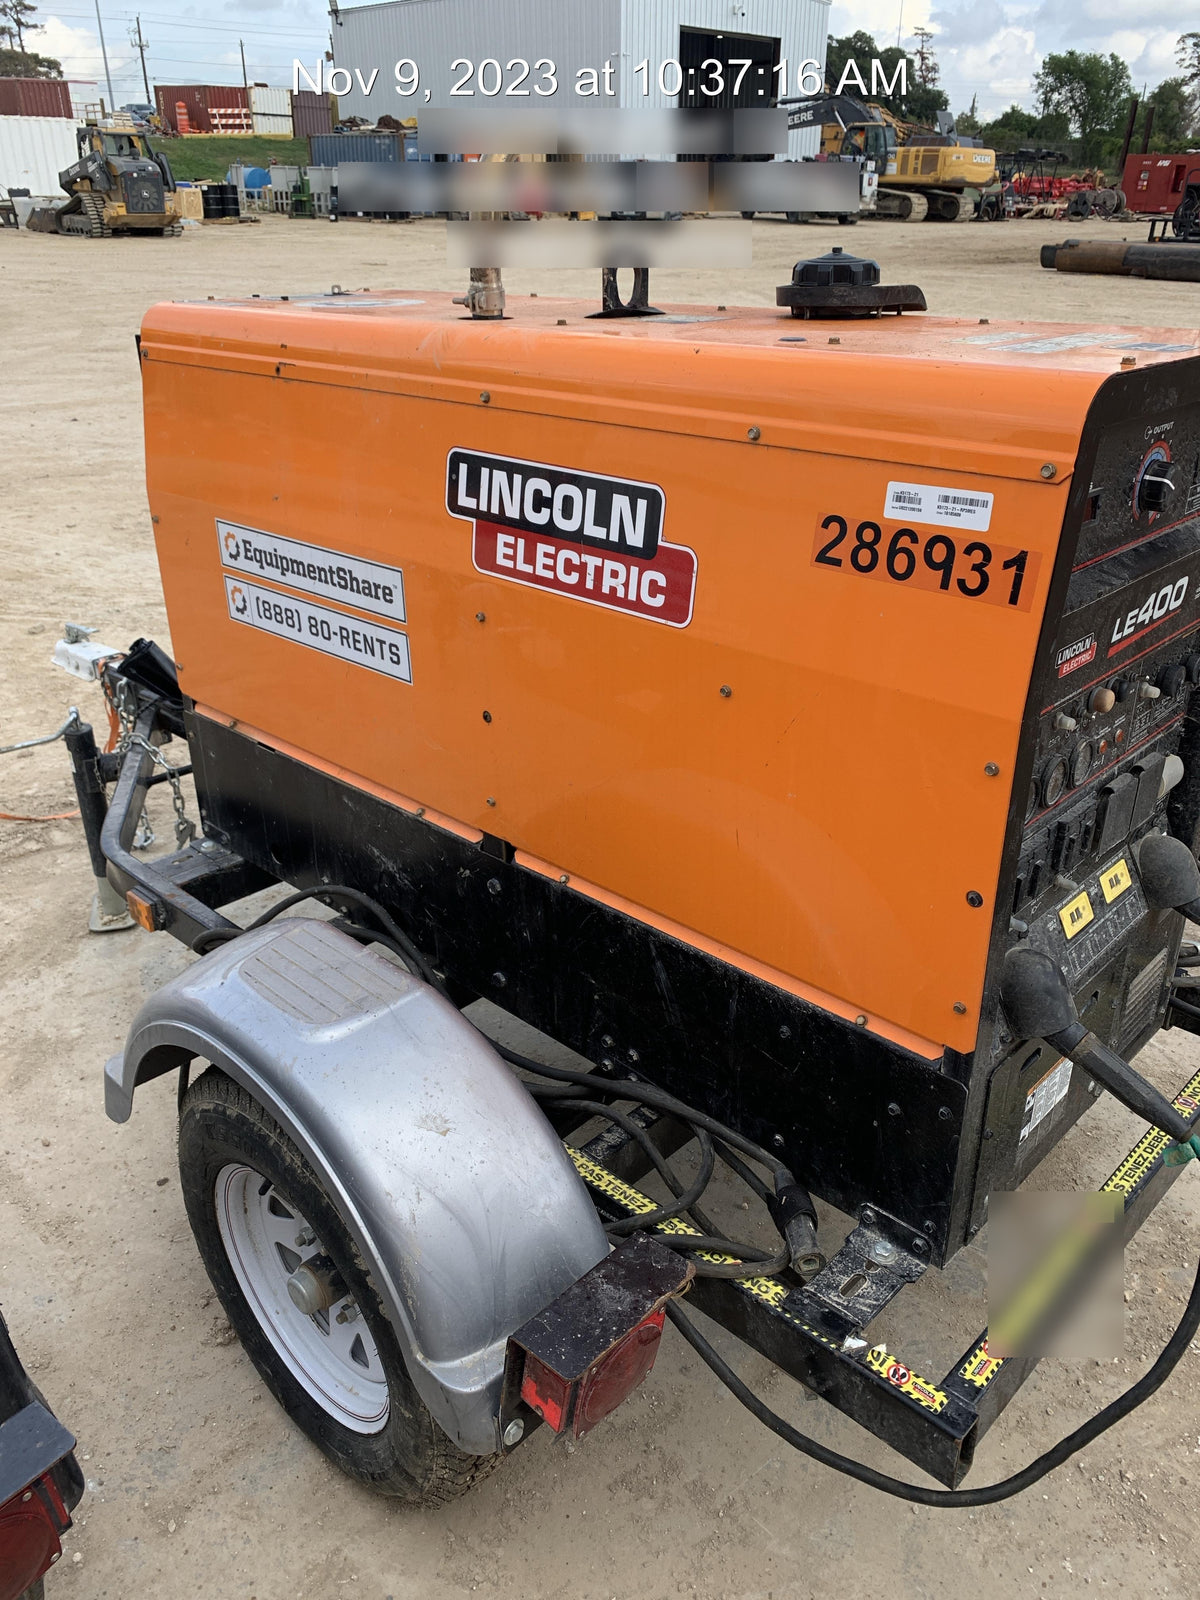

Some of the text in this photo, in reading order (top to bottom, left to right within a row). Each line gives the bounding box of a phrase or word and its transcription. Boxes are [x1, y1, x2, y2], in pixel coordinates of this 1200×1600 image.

[788, 110, 814, 126] EERE
[973, 153, 992, 164] DEERE
[1153, 421, 1175, 434] OUTPUT
[457, 462, 648, 549] LINCOLN
[496, 532, 667, 608] ELECTRIC
[815, 514, 1029, 606] 286931
[255, 596, 401, 666] (888) 80-RENTS
[1111, 575, 1189, 644] LE400
[1057, 636, 1092, 665] LINCOLN
[1062, 651, 1092, 673] ELECTRIC
[1119, 1130, 1169, 1183] TENEZ DEBO
[578, 1163, 604, 1182] PAS
[604, 1179, 652, 1211] TENEZ
